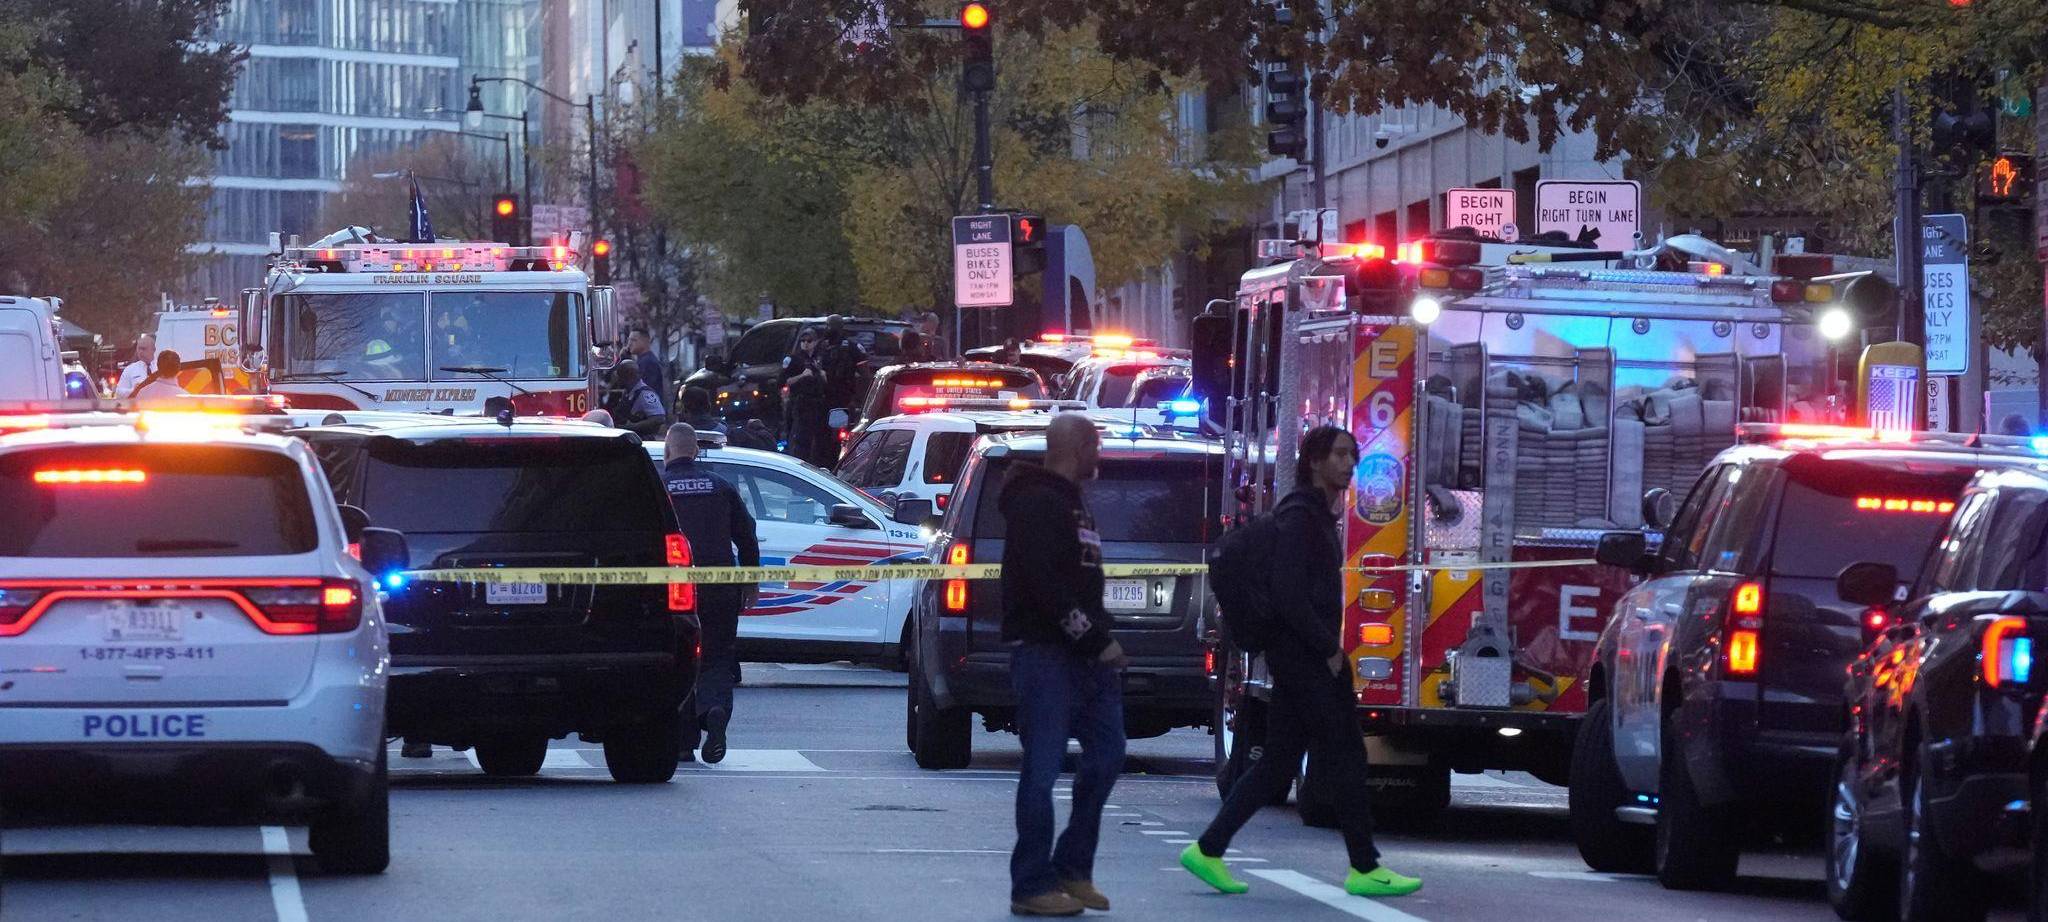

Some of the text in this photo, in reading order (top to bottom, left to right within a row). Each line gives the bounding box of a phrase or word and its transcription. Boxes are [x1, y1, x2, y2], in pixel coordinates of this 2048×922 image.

[1460, 196, 1503, 209] BEGIN
[1569, 190, 1607, 204] BEGIN
[1460, 212, 1503, 226] RIGHT
[1541, 208, 1634, 223] RIGHT TURN LANE
[970, 221, 993, 229] RIGHT
[972, 232, 993, 241] LANE
[1922, 226, 1943, 239] IGHT
[966, 247, 1000, 258] BUSES
[1924, 245, 1944, 258] ANE
[967, 260, 1000, 270] BIKES
[373, 274, 482, 284] FRANKLIN SQUARE
[968, 270, 998, 280] ONLY
[1928, 292, 1954, 309] KES
[1924, 311, 1952, 327] NLY
[1371, 341, 1399, 379] E
[1871, 367, 1917, 379] KEEP
[385, 388, 477, 402] MIDNIGHT EXPRESS
[567, 393, 586, 413] 16
[1370, 390, 1396, 430] 6
[667, 481, 714, 492] POLICE
[599, 572, 618, 582] LINE
[619, 571, 648, 582] POLICE
[687, 570, 797, 582] POLICE LINE DO NOT CROSS
[834, 568, 946, 580] POLICE LINE DO NOT CROSS
[1112, 586, 1144, 601] 81295
[1559, 584, 1601, 642] E
[79, 647, 216, 661] 1-877-4FPS-411
[83, 713, 206, 738] POLICE
